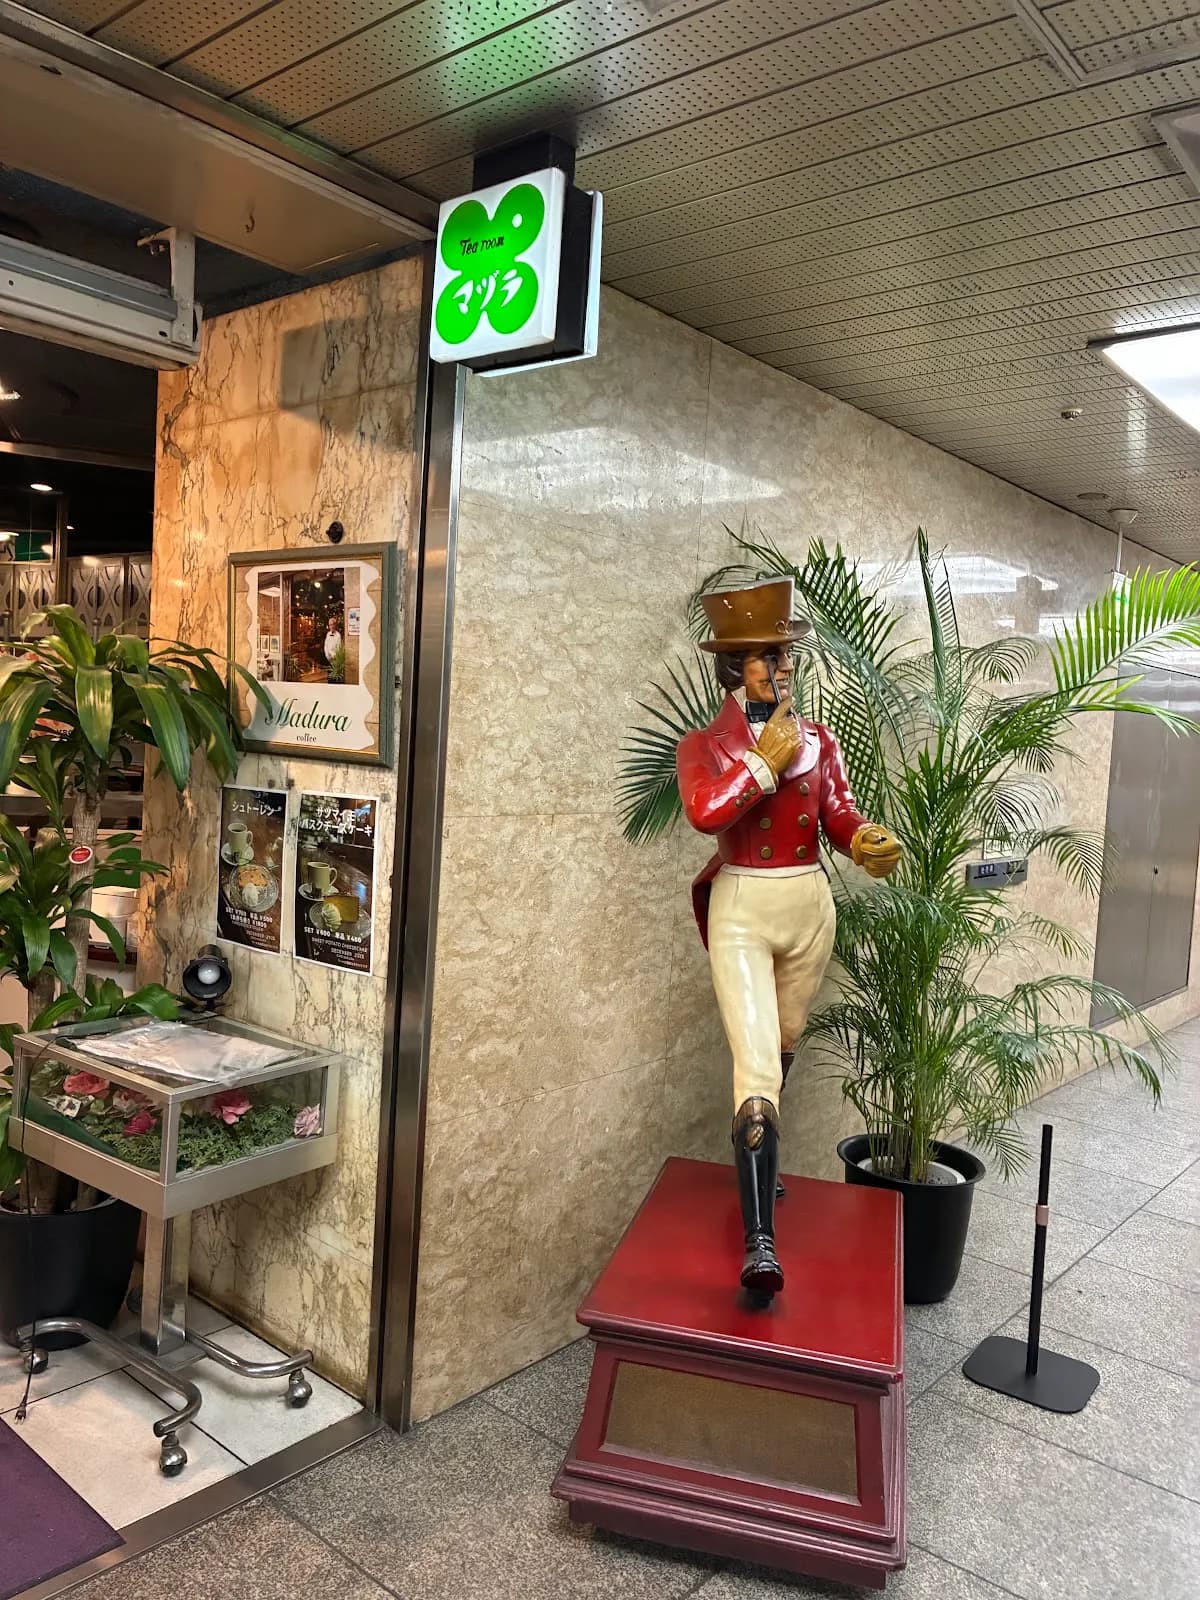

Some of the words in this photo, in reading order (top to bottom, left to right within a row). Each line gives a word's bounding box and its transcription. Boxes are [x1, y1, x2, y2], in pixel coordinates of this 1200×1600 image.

[459, 238, 477, 256] Tea
[480, 235, 504, 253] room
[452, 269, 523, 314] マヅラ
[265, 698, 351, 732] Madura
[296, 733, 317, 743] coffee
[232, 801, 275, 817] シュトーレン
[316, 807, 356, 824] サツマイモ
[299, 818, 373, 837] バスクチーズケーキ
[304, 926, 314, 934] SET
